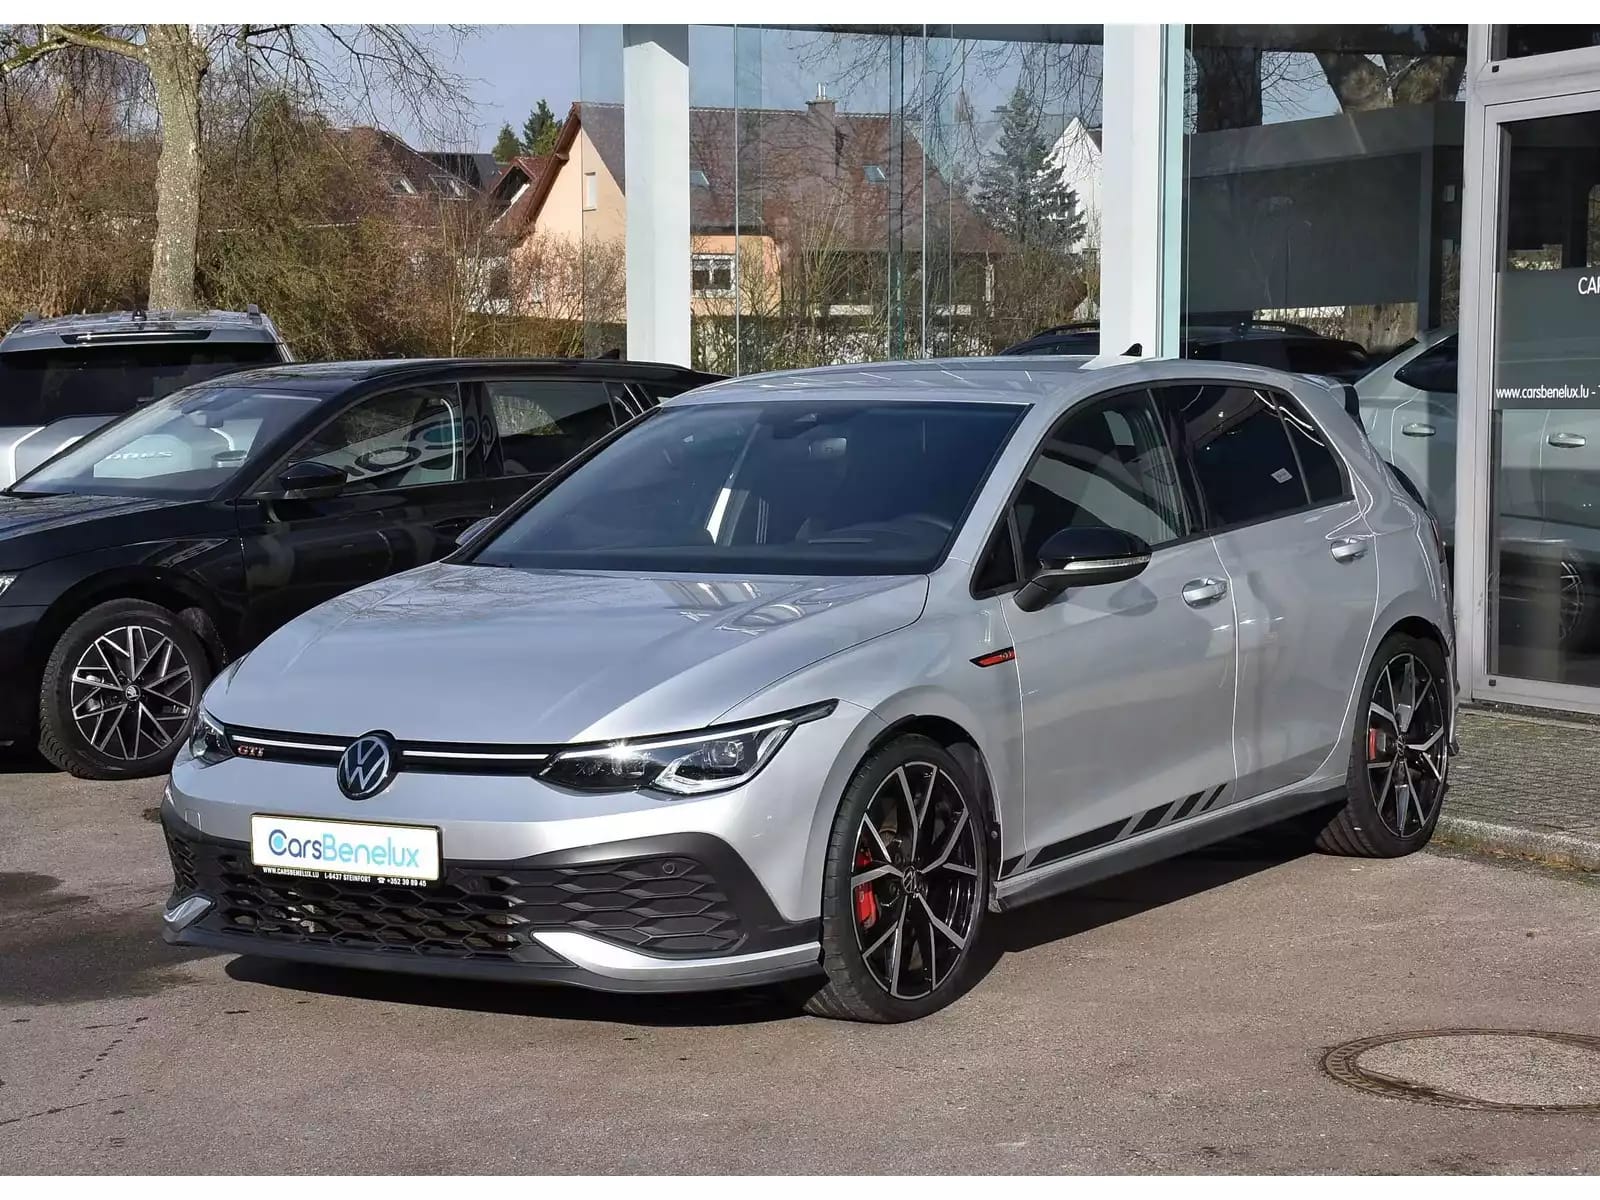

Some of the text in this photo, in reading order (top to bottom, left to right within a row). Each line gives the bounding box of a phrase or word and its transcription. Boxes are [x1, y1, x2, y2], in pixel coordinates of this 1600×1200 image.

[1496, 384, 1589, 399] www.carsbenelux.lu
[237, 744, 265, 758] GTI
[268, 829, 419, 868] CarsBenelux
